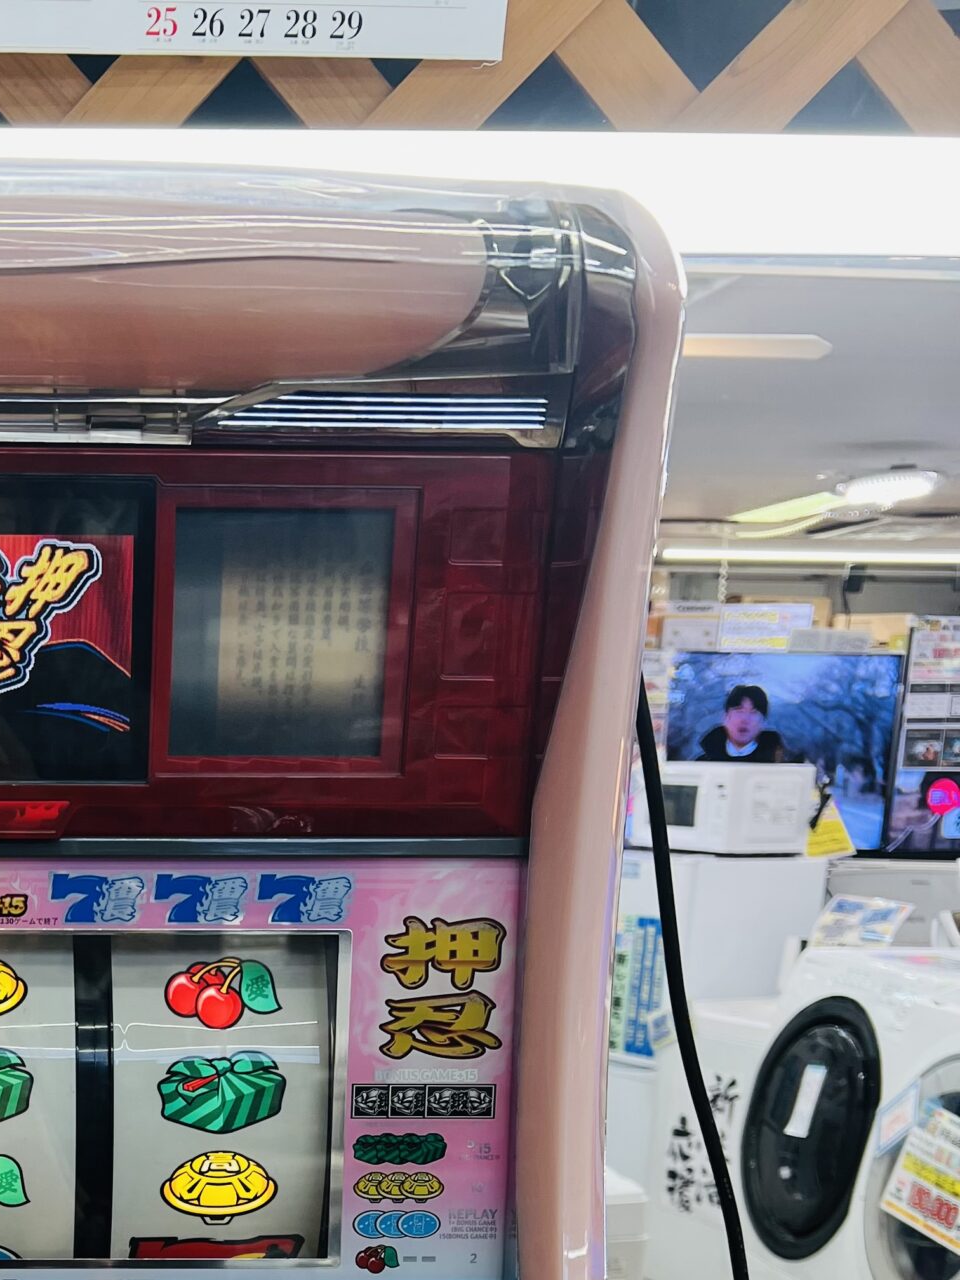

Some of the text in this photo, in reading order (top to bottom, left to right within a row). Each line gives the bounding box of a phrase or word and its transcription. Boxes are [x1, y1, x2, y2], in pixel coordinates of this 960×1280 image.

[145, 6, 363, 40] 25 26 27 28 29
[244, 973, 271, 1001] 愛
[379, 916, 507, 1060] 押忍
[469, 1253, 478, 1264] 2
